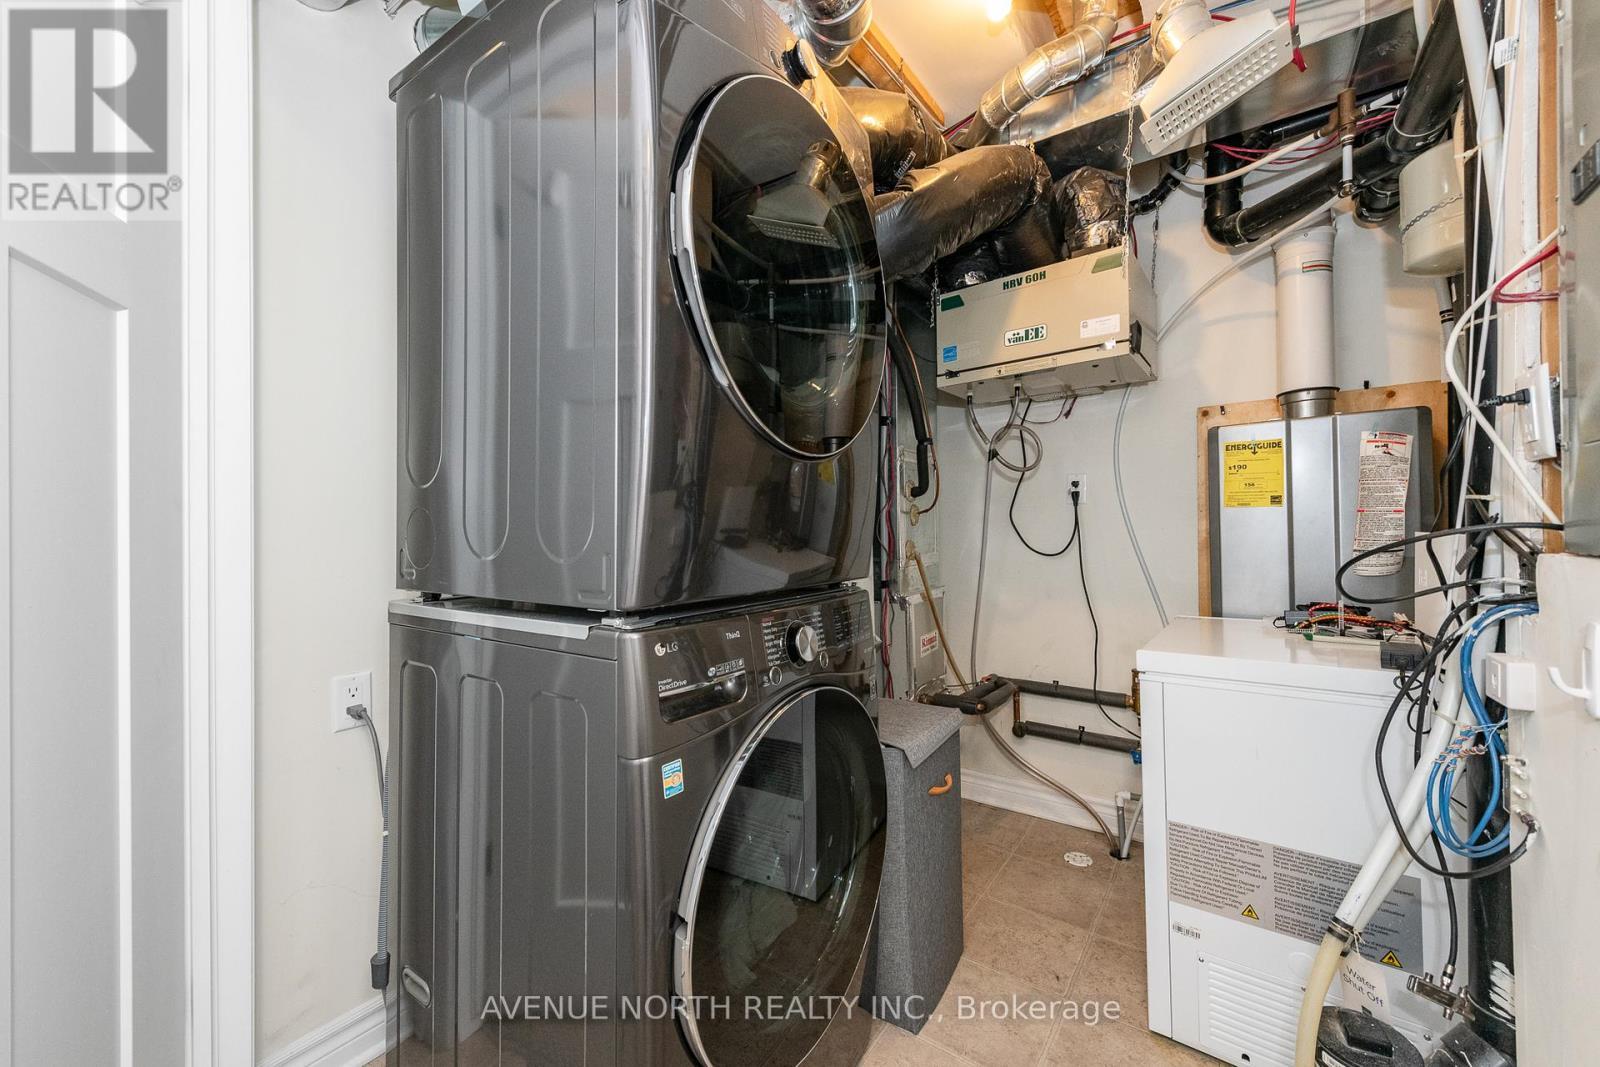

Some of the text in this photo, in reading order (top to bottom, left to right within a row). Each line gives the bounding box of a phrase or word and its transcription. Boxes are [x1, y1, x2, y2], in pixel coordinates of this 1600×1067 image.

[1003, 270, 1046, 290] HRV 60H
[667, 642, 678, 652] LG
[1346, 965, 1376, 990] Water
[1343, 973, 1383, 1007] Shut Off
